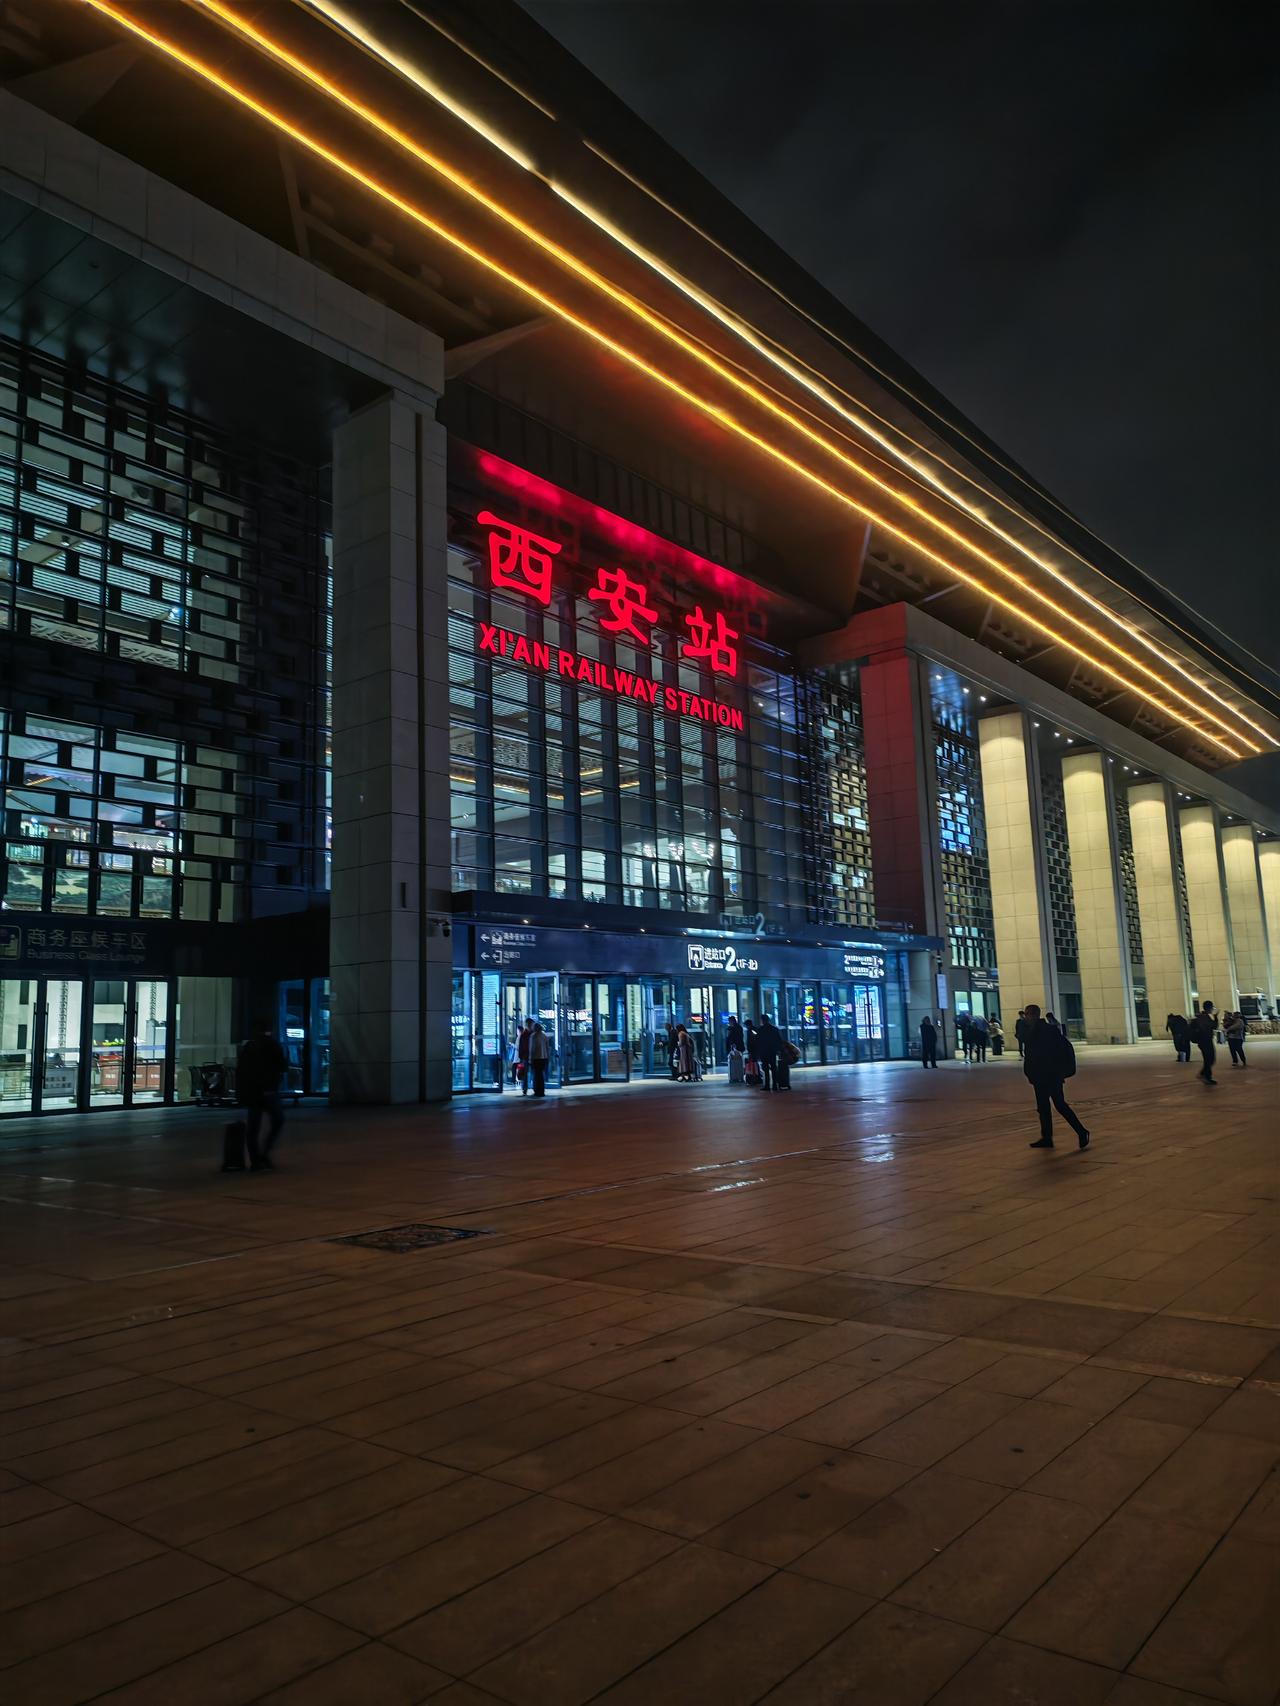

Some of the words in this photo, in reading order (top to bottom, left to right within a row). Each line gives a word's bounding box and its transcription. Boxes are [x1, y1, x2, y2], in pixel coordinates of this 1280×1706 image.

[477, 511, 739, 677] 西安站
[479, 623, 549, 670] XI'AN
[558, 650, 658, 704] RAILWAY
[665, 687, 743, 730] STATION
[27, 928, 148, 950] 商务座候车区
[26, 948, 75, 960] Business
[704, 947, 726, 961] 进站口
[725, 946, 737, 972] 2
